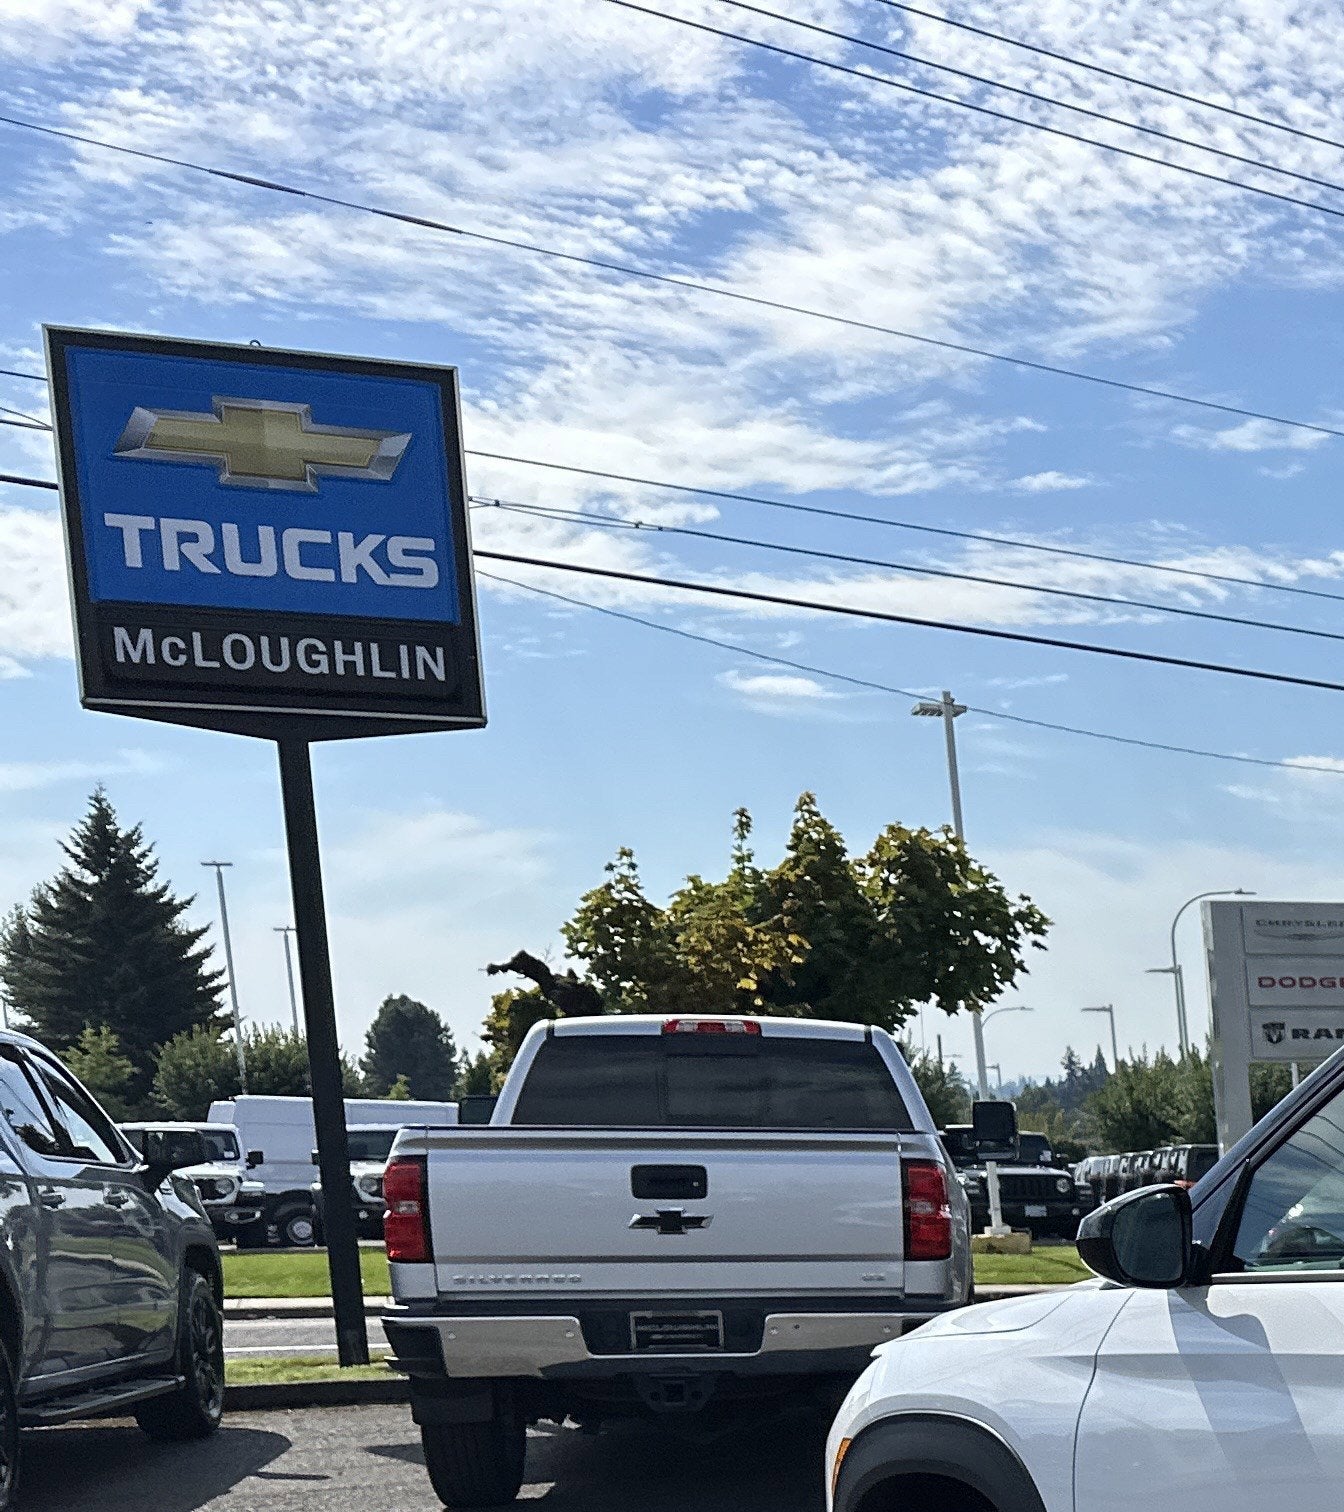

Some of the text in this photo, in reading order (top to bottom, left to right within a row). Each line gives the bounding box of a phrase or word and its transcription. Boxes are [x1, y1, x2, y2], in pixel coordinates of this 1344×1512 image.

[104, 512, 439, 589] TRUCKS
[113, 626, 447, 682] McLOUGHLIN
[452, 1273, 582, 1285] SILVERADO
